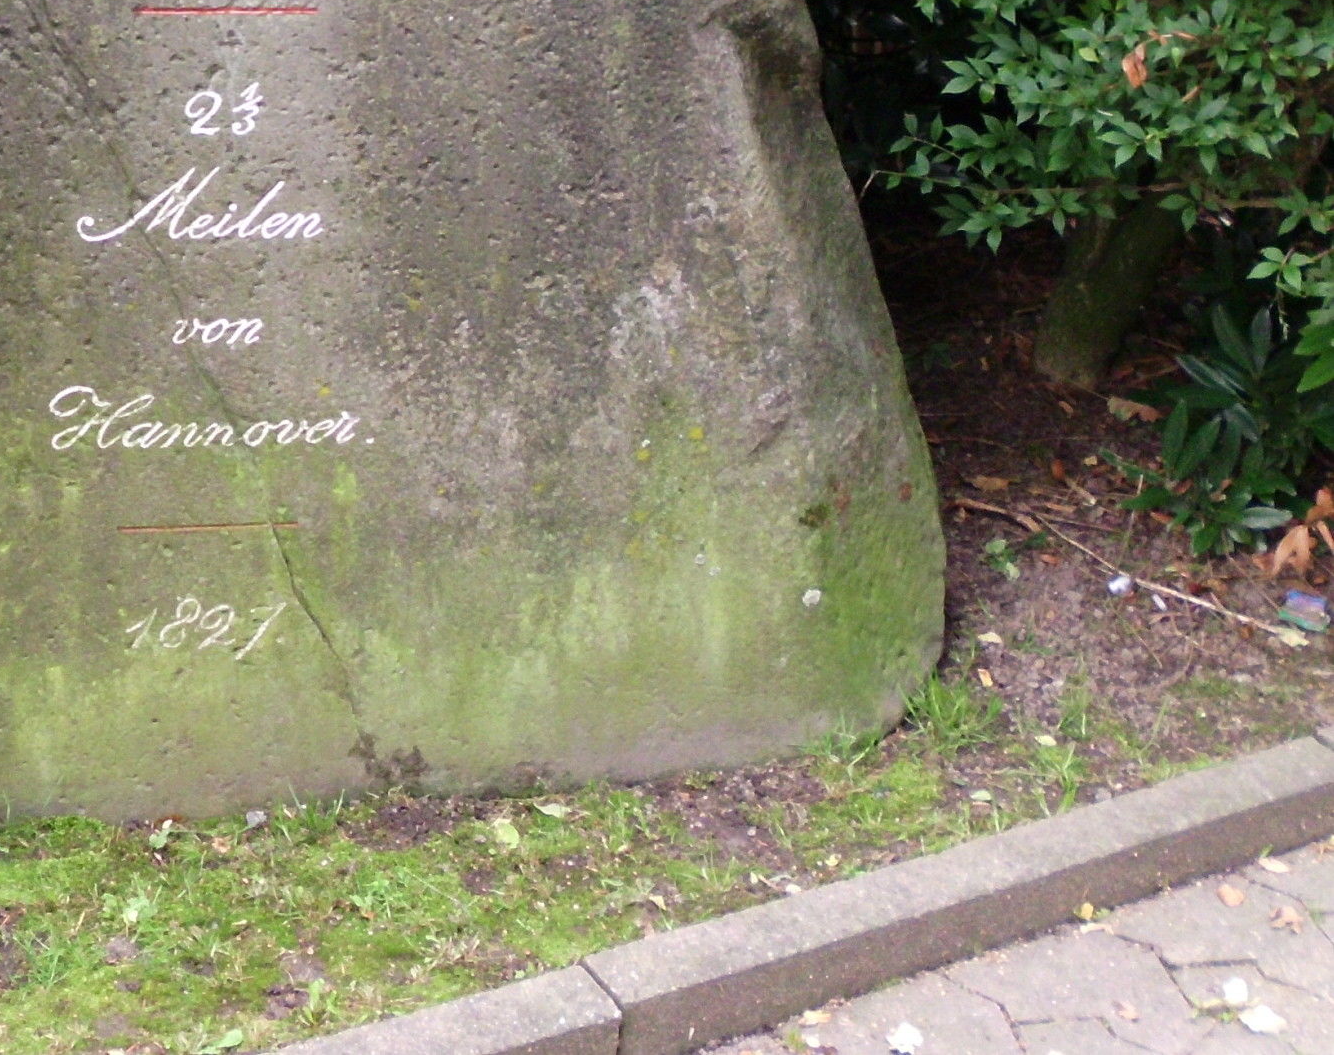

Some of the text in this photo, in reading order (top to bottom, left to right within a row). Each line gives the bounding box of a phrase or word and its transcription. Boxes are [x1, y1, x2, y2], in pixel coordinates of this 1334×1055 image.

[77, 167, 324, 241] Meilen
[172, 315, 265, 345] von
[49, 385, 376, 450] Hannover.
[124, 594, 287, 662] 1827
